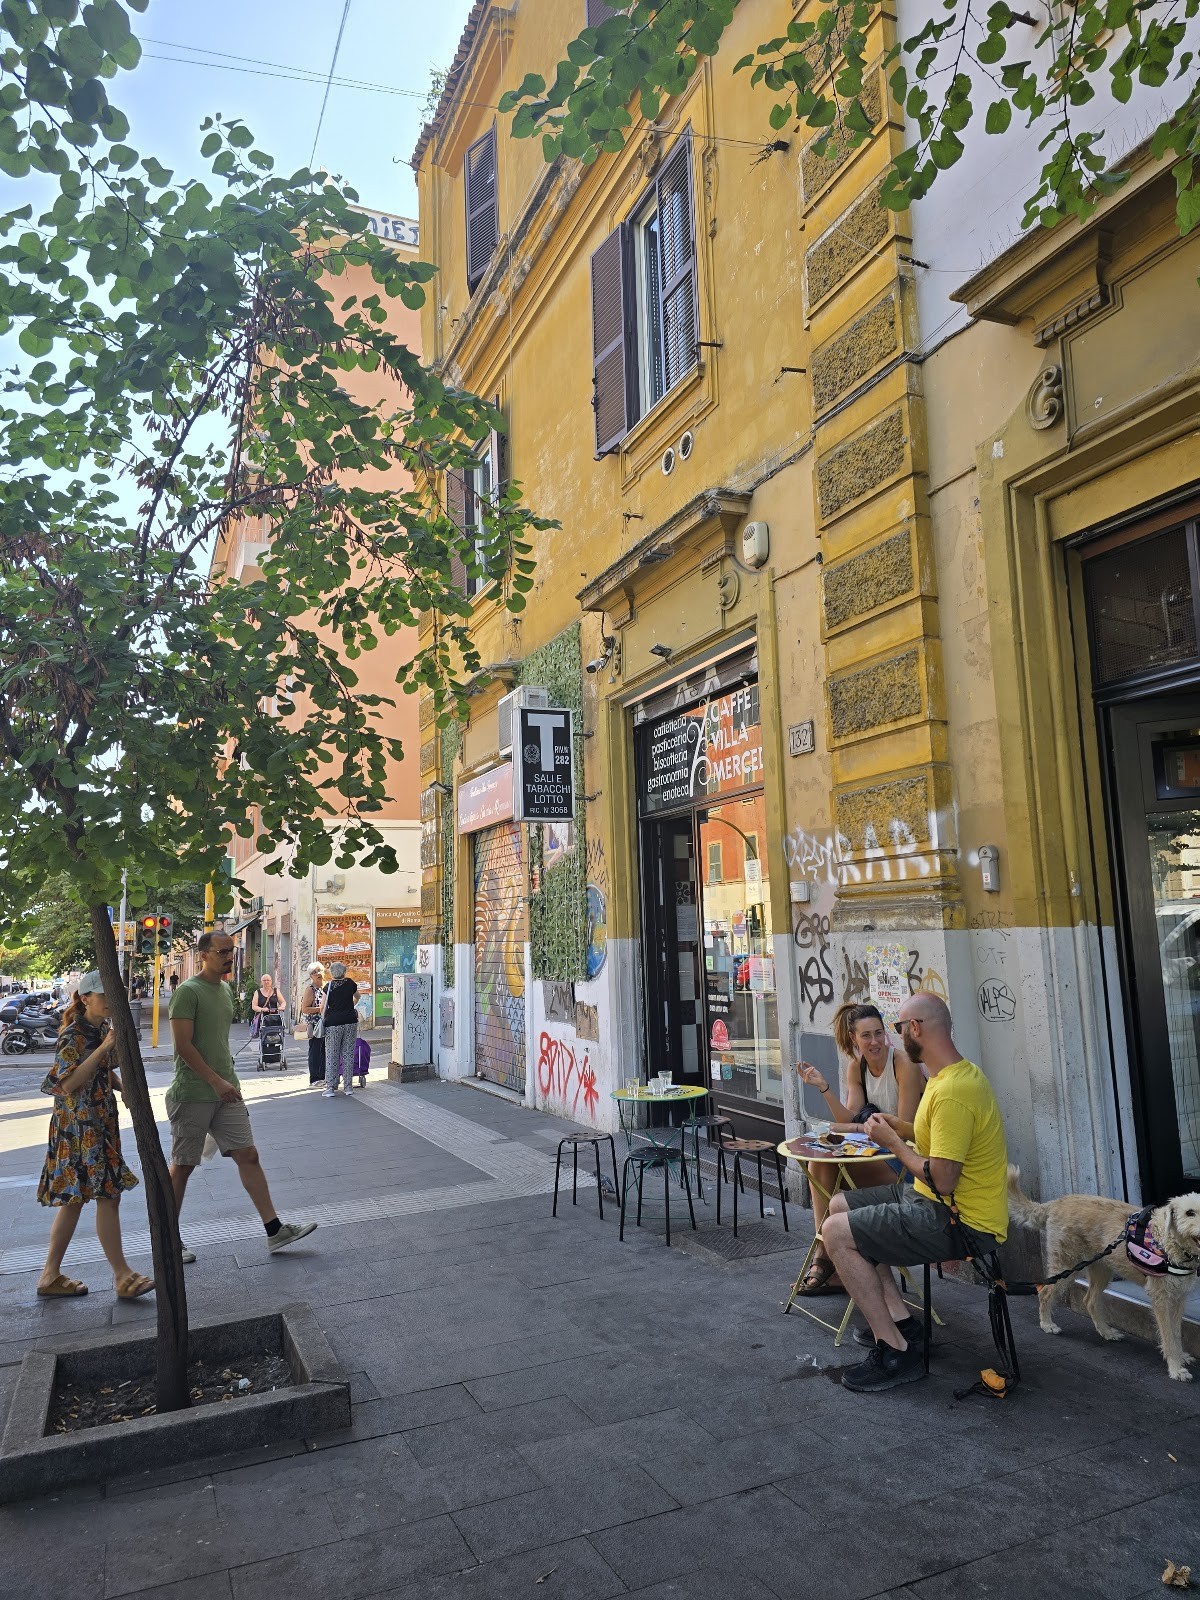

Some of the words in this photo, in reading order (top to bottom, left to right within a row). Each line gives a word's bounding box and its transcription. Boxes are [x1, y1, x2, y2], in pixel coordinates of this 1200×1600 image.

[653, 715, 687, 738] caffetteria
[710, 720, 749, 752] VILLA
[528, 713, 565, 771] T
[651, 731, 687, 758] pasticceria
[791, 729, 808, 750] 132
[555, 755, 570, 765] 282
[653, 748, 688, 772] biscotteria
[525, 783, 571, 794] TABACCHI
[534, 773, 554, 783] SALI
[556, 774, 563, 783] E
[647, 765, 689, 793] gastronomia
[534, 794, 564, 804] LOTTO
[662, 784, 689, 802] enoteca
